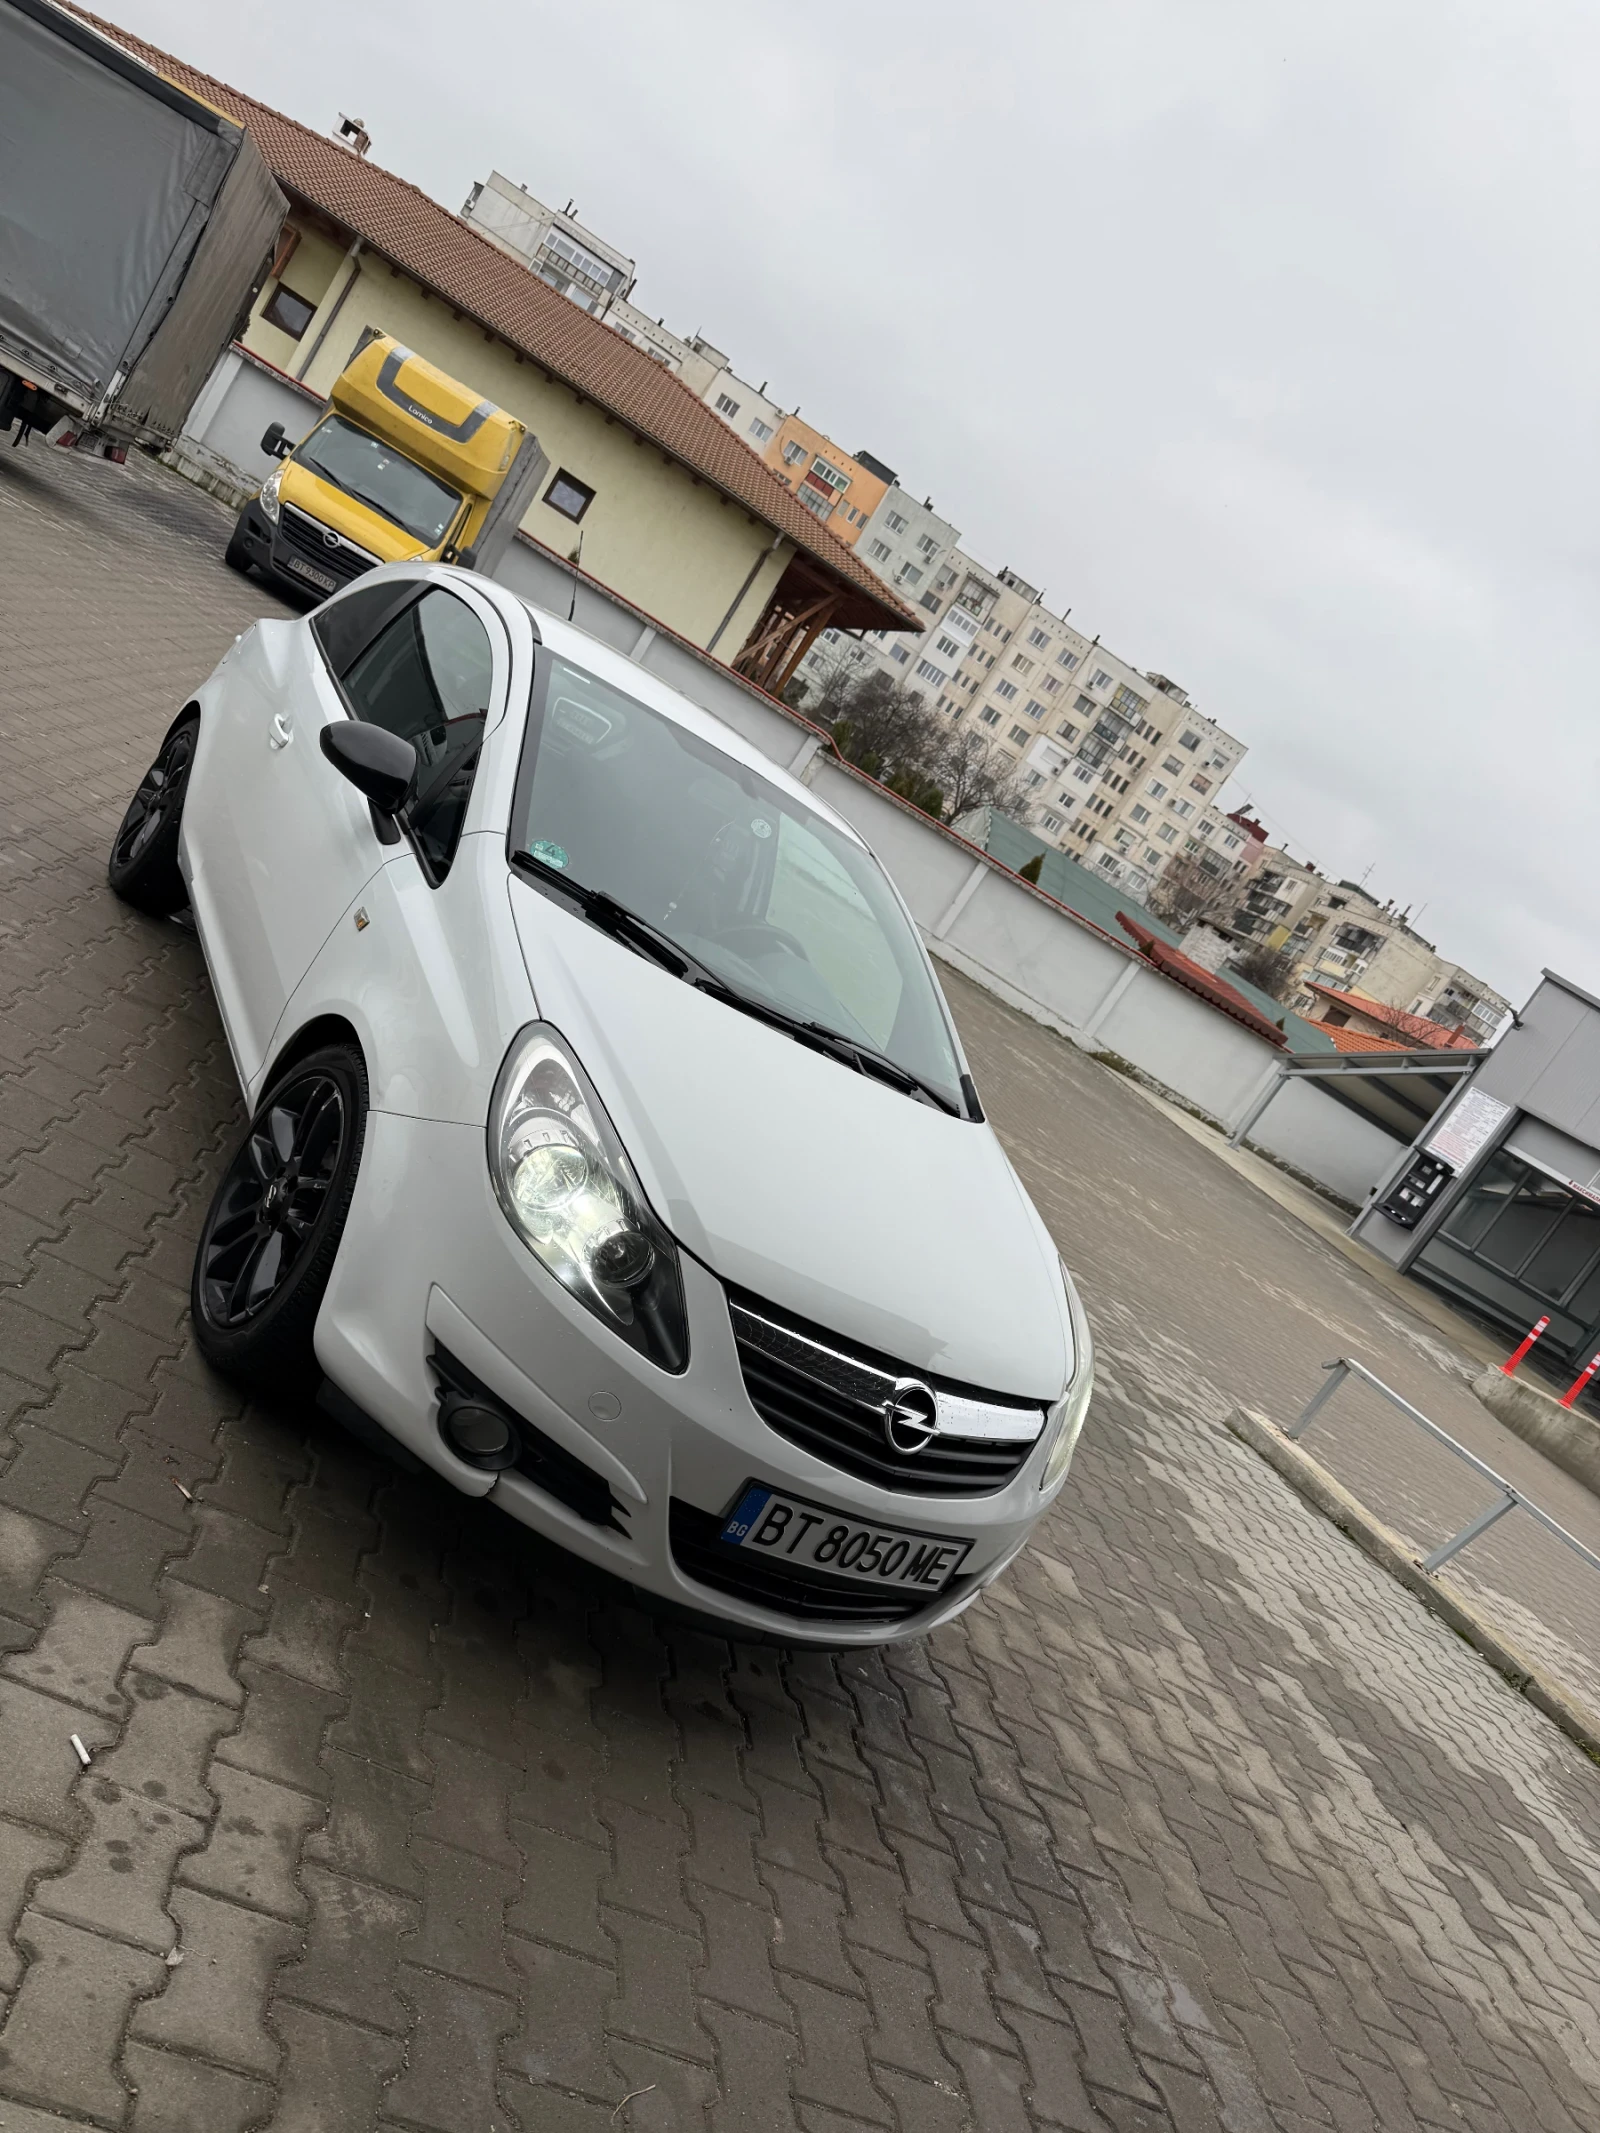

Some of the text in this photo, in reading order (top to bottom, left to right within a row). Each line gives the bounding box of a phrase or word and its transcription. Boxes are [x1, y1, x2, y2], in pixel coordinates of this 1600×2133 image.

[409, 405, 433, 424] Lomico
[293, 560, 335, 588] BT 9300 KP
[545, 844, 556, 857] 4
[1572, 1183, 1600, 1203] МАКСИМАЛ
[726, 1520, 749, 1537] BG
[752, 1503, 958, 1585] BT 8050 ME
